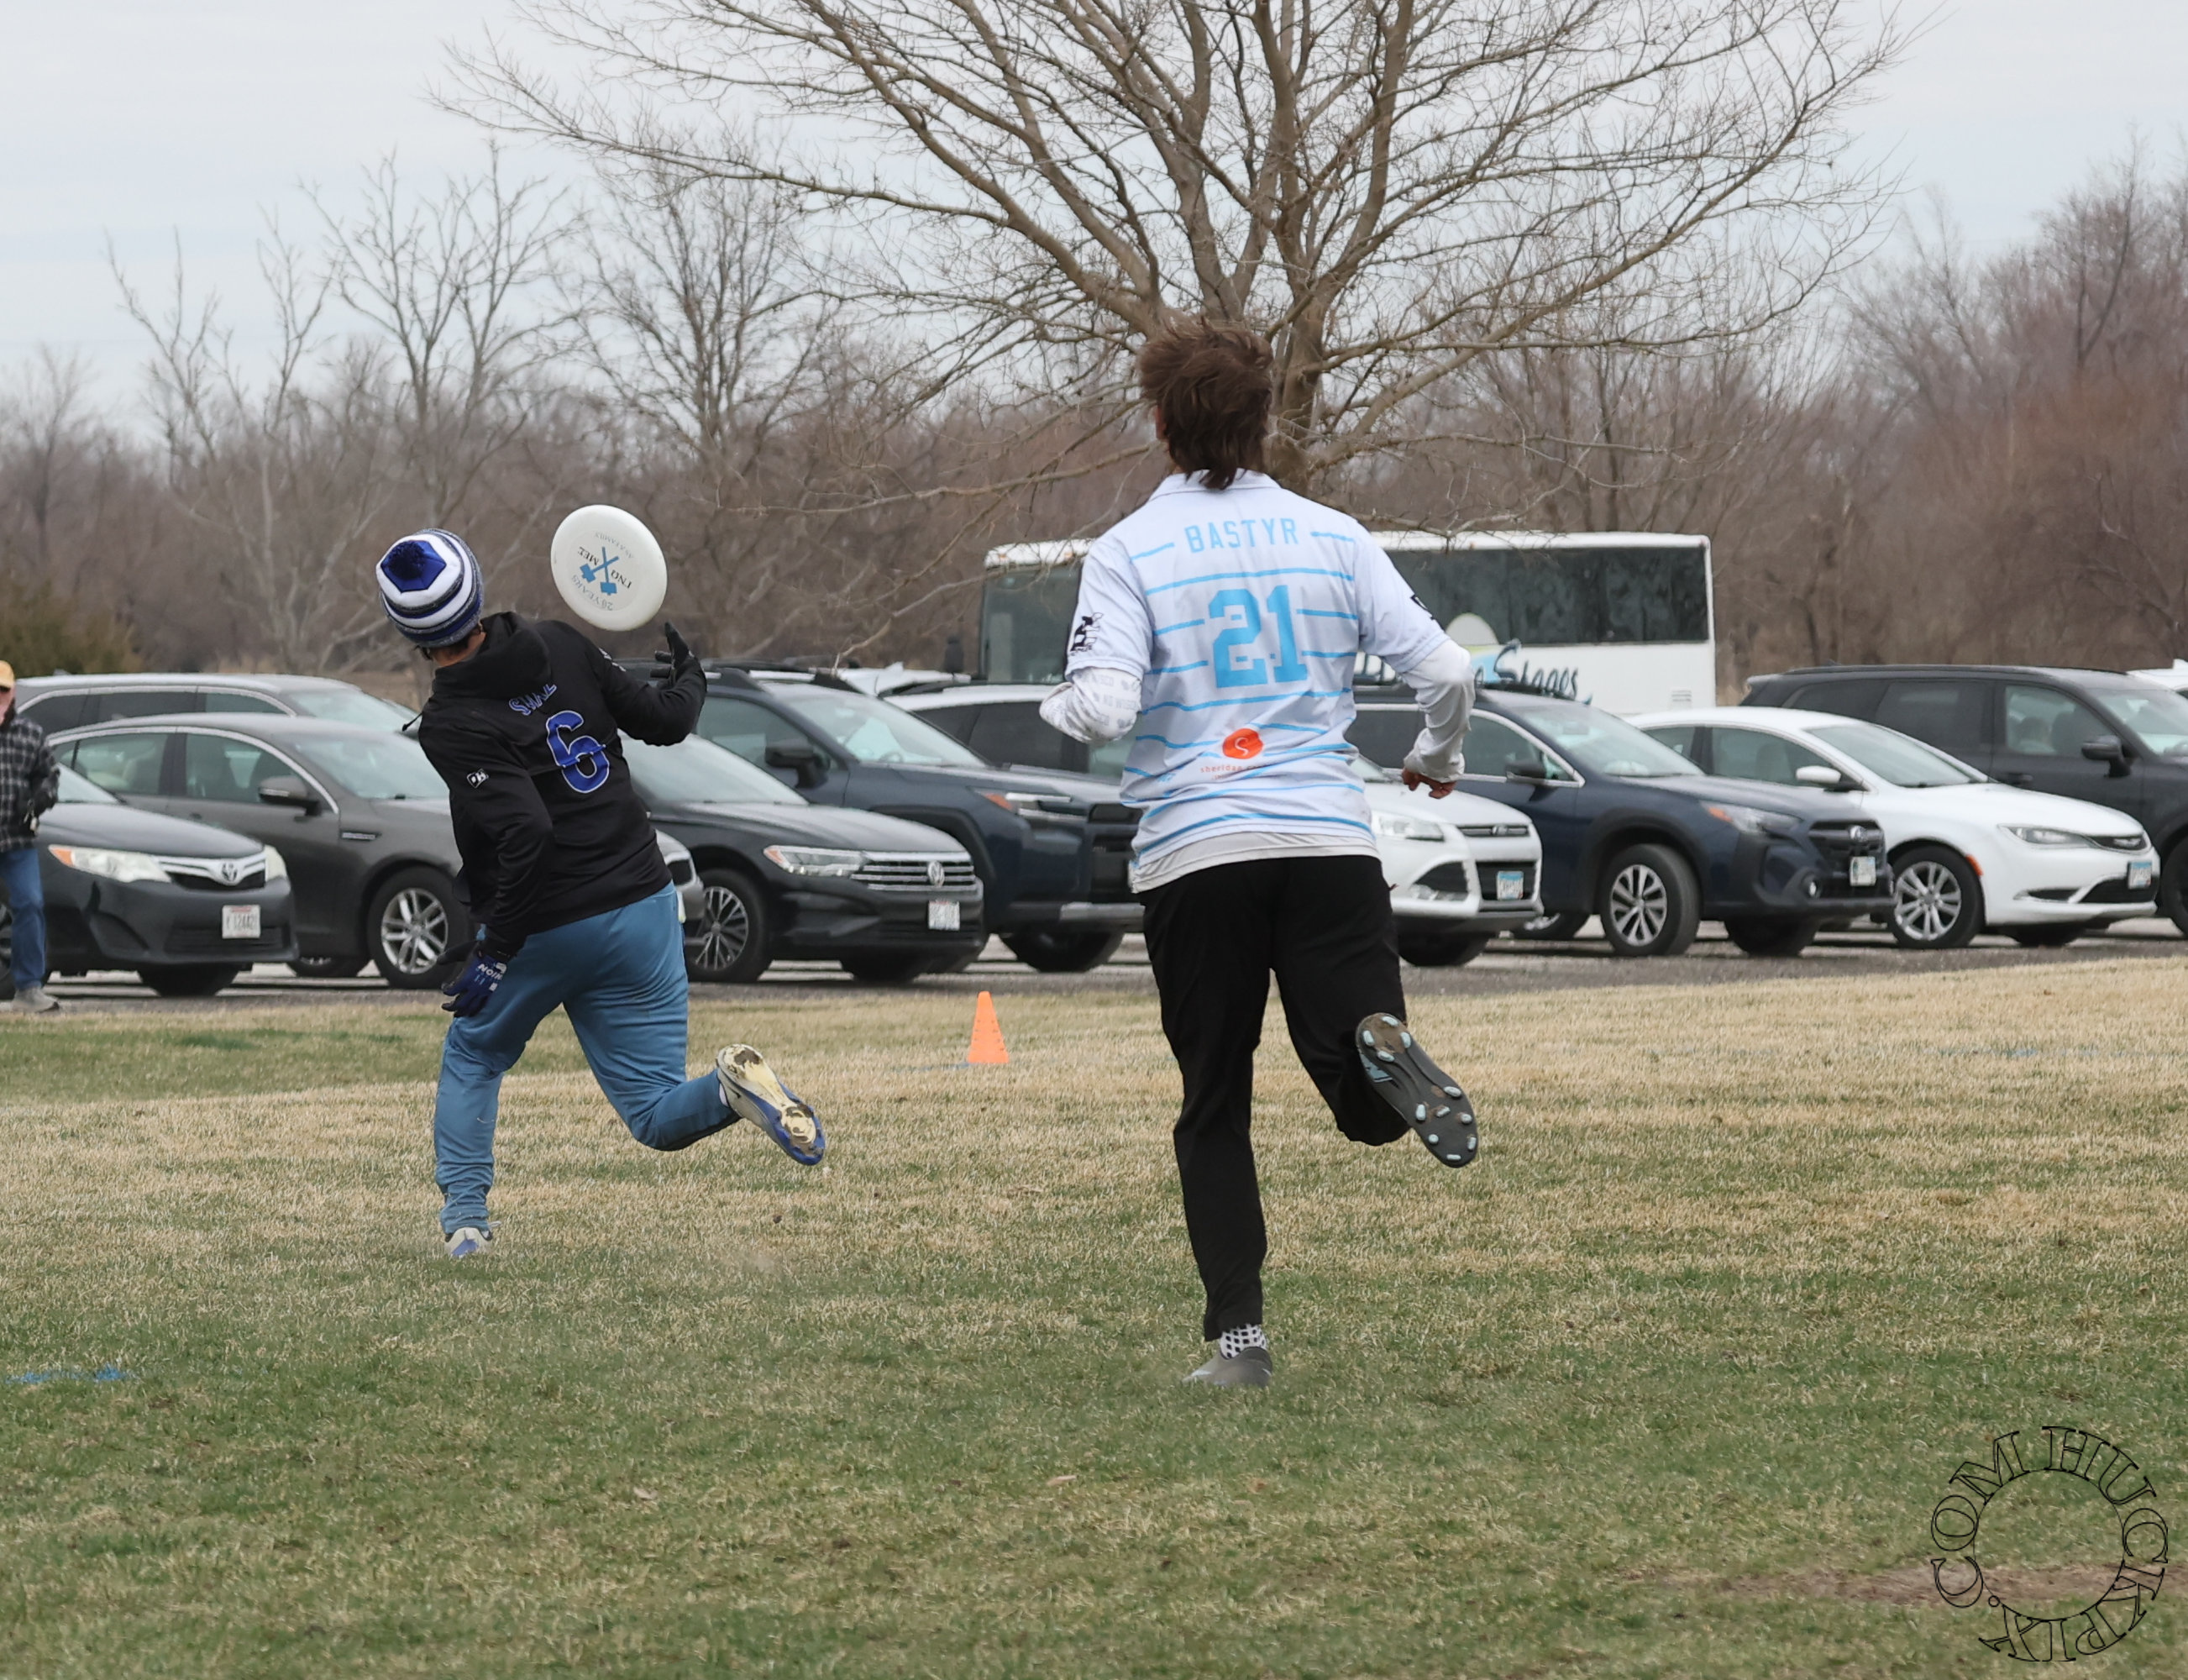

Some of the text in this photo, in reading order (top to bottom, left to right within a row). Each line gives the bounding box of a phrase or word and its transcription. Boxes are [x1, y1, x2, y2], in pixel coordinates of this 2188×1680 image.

[1184, 517, 1299, 554] BASTYR
[1208, 585, 1309, 689] 21
[546, 710, 611, 794] 6
